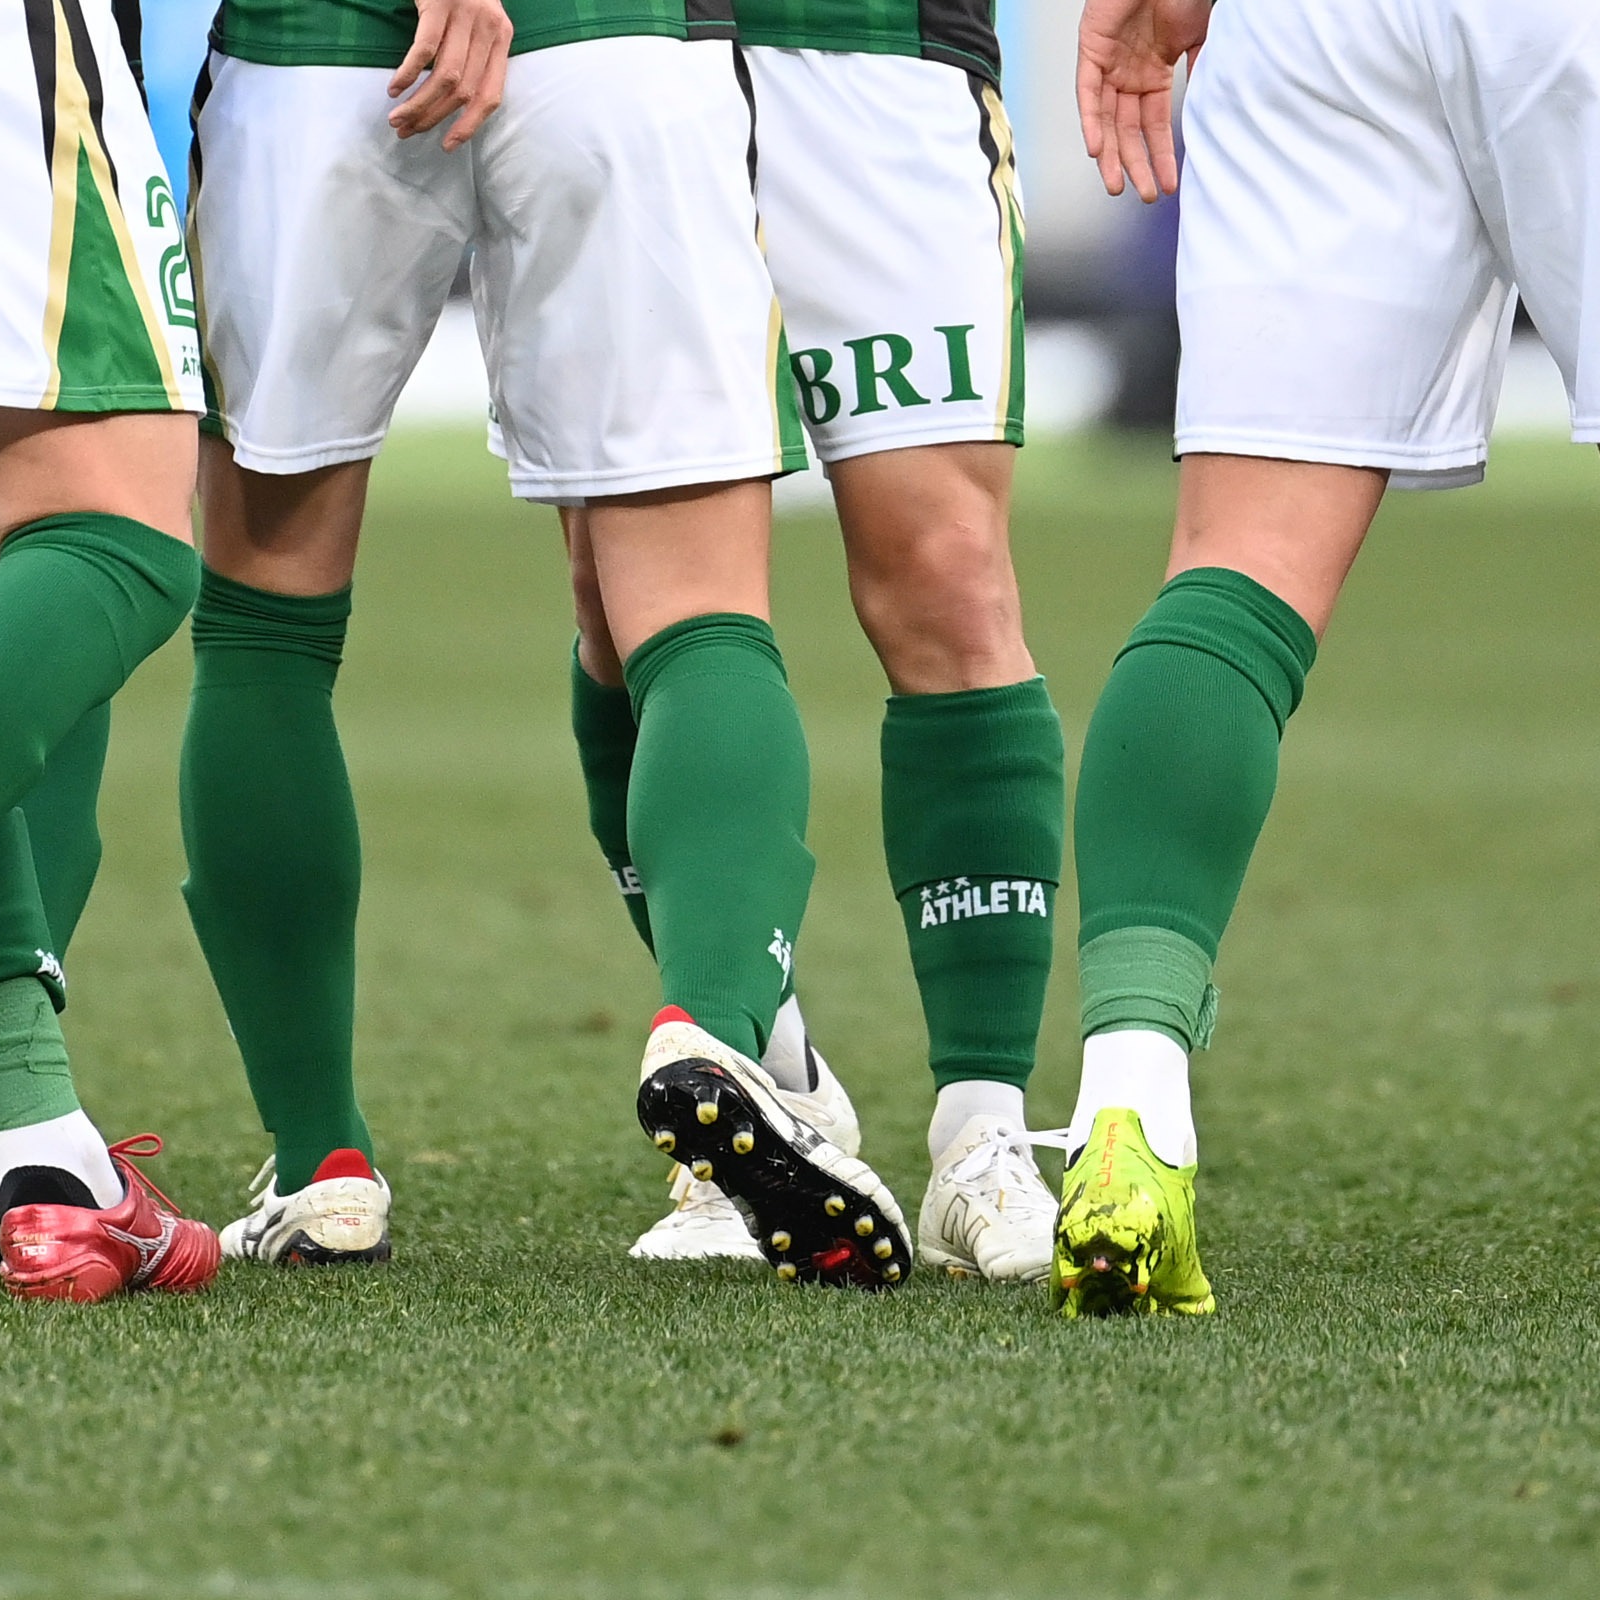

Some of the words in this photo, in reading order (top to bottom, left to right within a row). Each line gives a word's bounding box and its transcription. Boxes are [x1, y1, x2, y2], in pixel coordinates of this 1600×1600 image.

[789, 324, 983, 425] BRI
[920, 881, 1046, 928] ATHLETA
[1099, 1122, 1117, 1187] ULTRA
